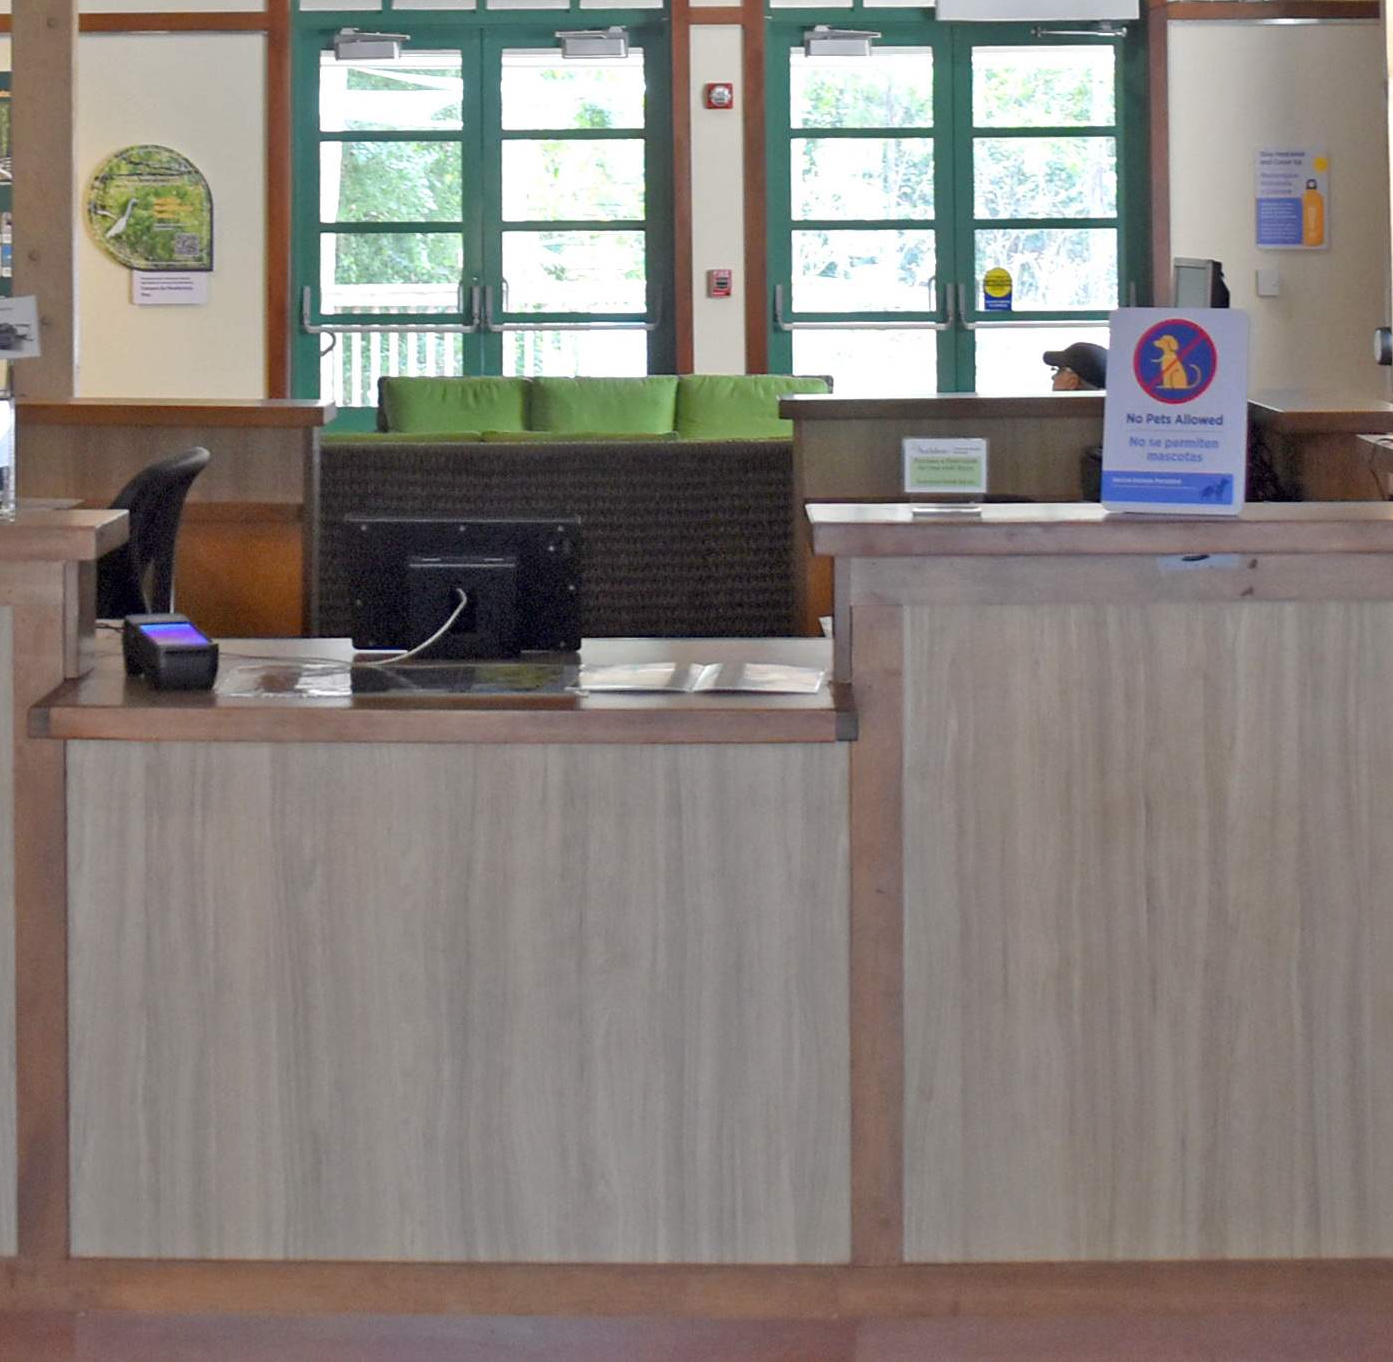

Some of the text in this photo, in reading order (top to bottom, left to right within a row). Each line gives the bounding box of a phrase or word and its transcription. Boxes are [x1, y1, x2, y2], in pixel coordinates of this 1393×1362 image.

[1126, 414, 1223, 425] No Pets Allowed
[1129, 437, 1219, 450] No se permiten
[1147, 452, 1203, 462] mascotas
